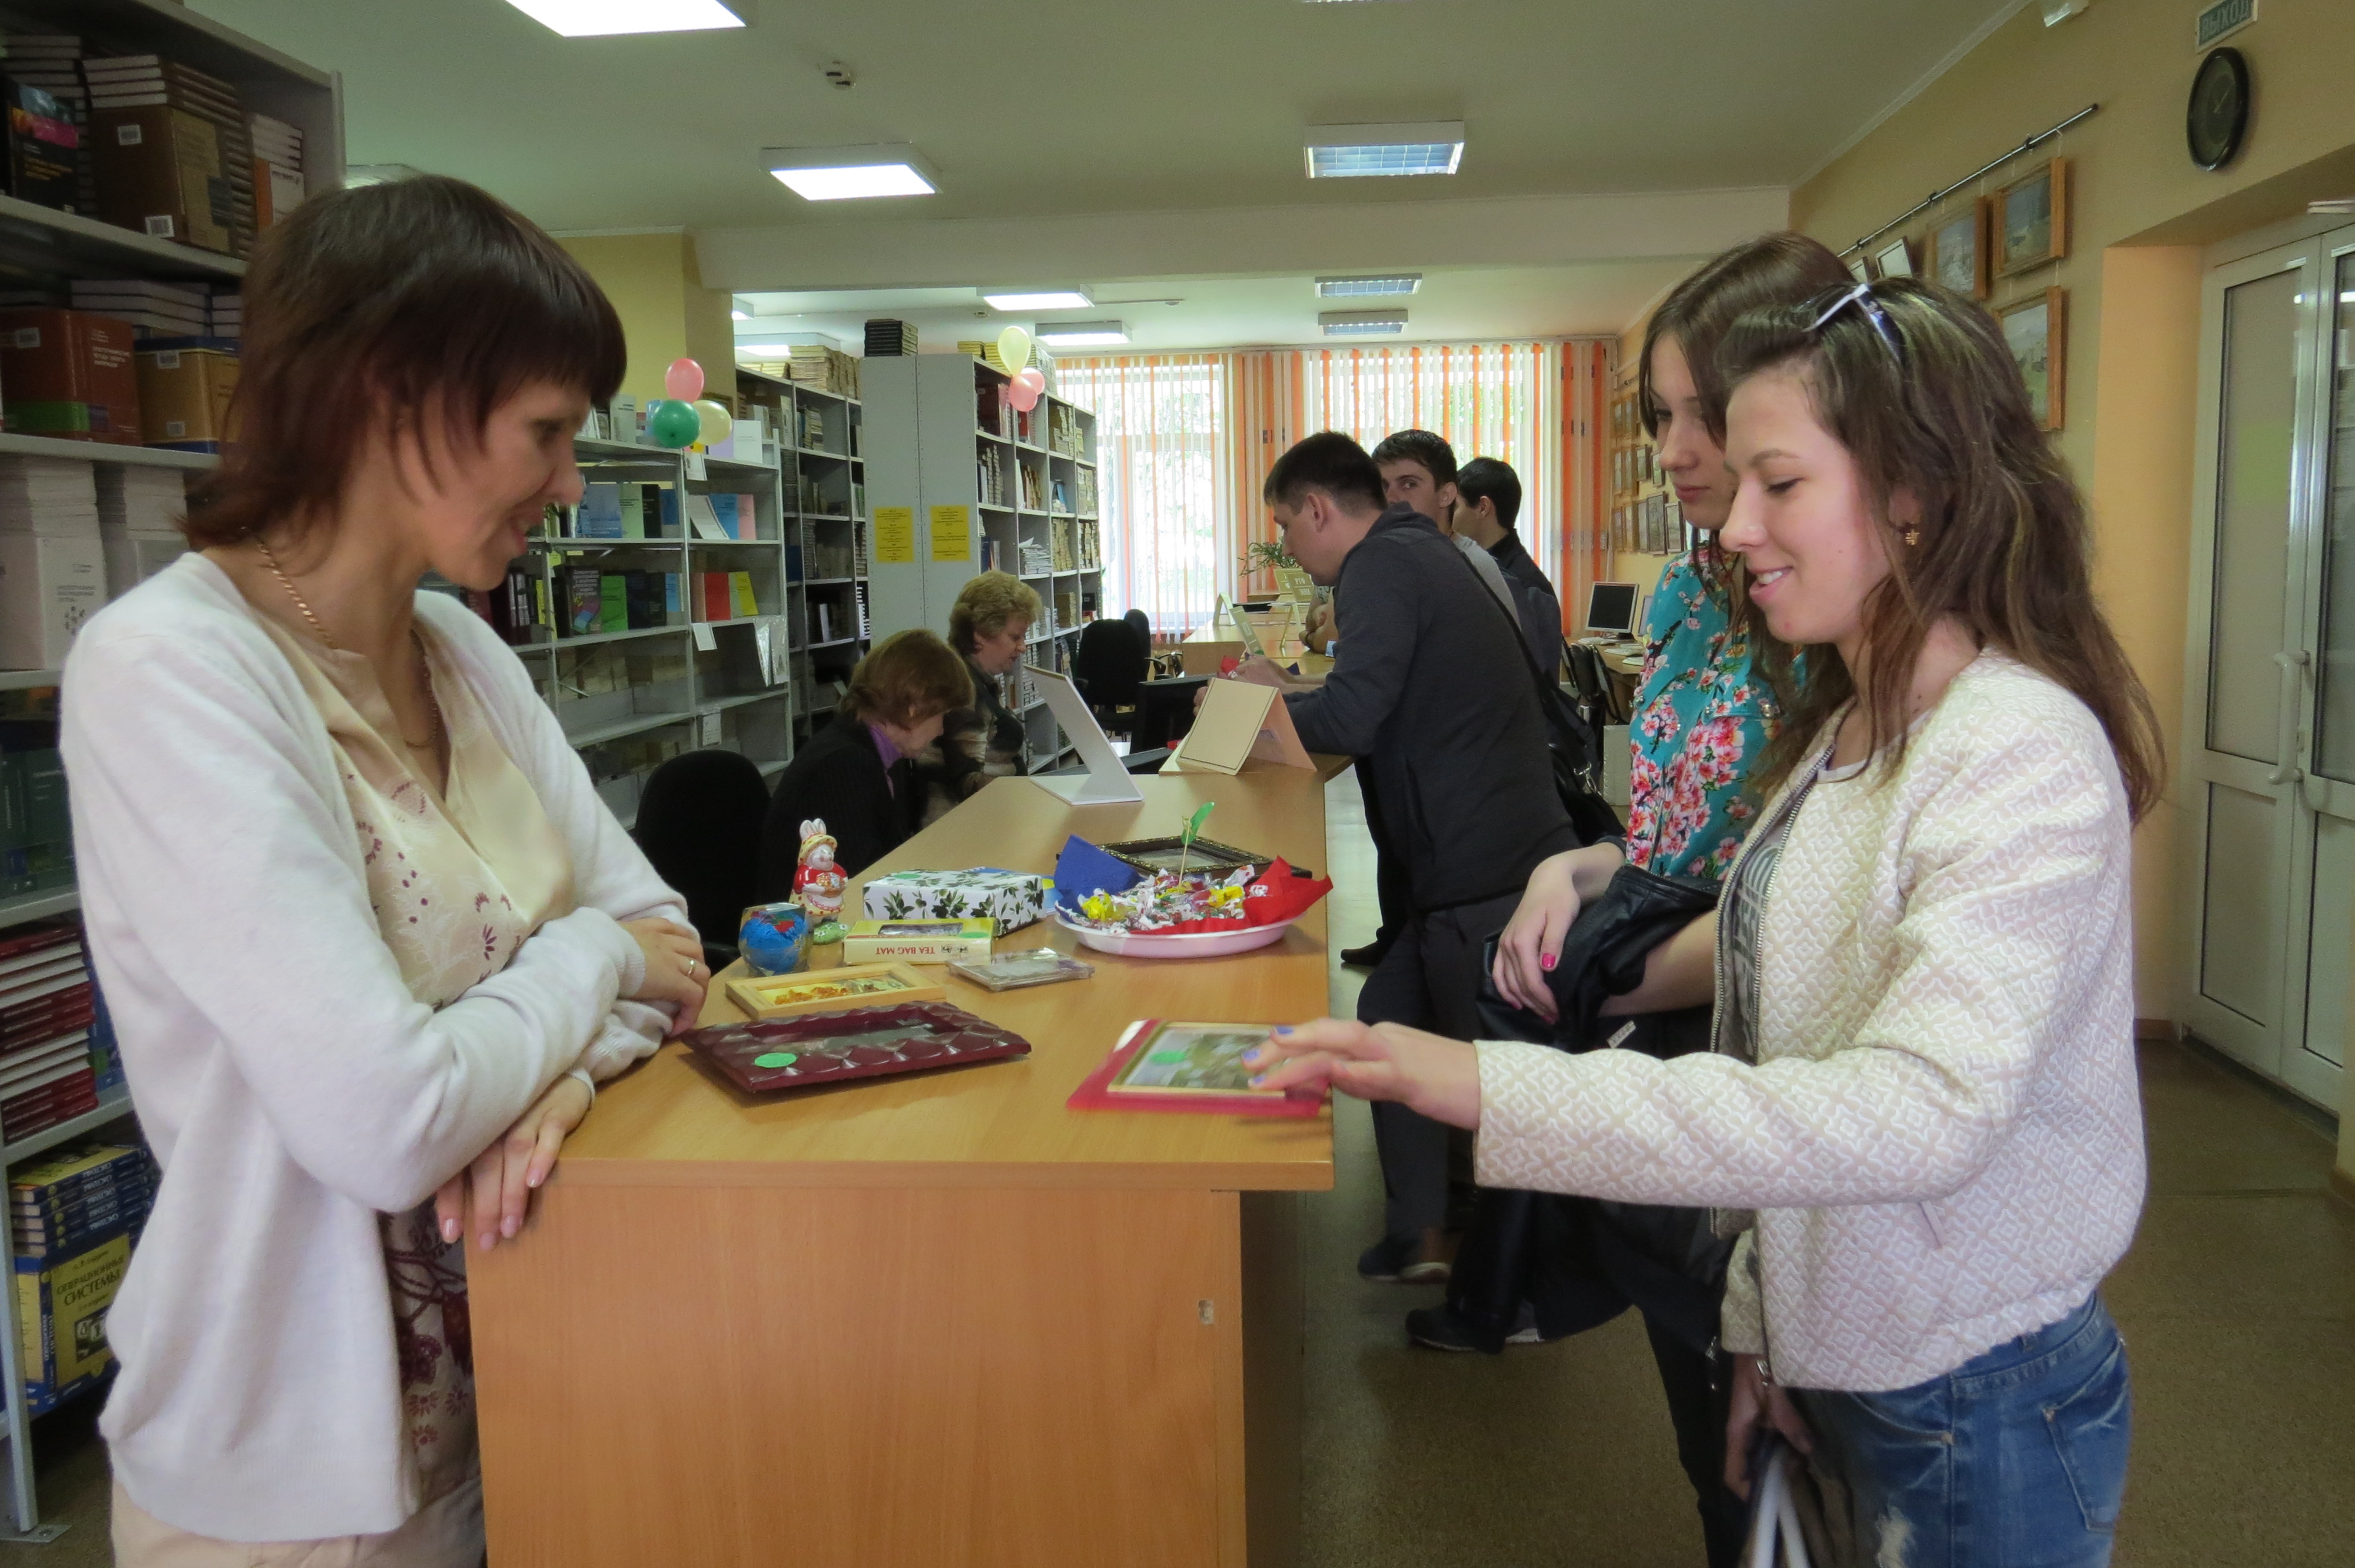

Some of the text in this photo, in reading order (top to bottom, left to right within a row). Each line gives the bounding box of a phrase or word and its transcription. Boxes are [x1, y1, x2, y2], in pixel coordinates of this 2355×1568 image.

[875, 946, 895, 955] MAT
[56, 1254, 124, 1295] ОПЕРАЦИОННЫЕ
[64, 1268, 121, 1306] СИСТЕМЫ
